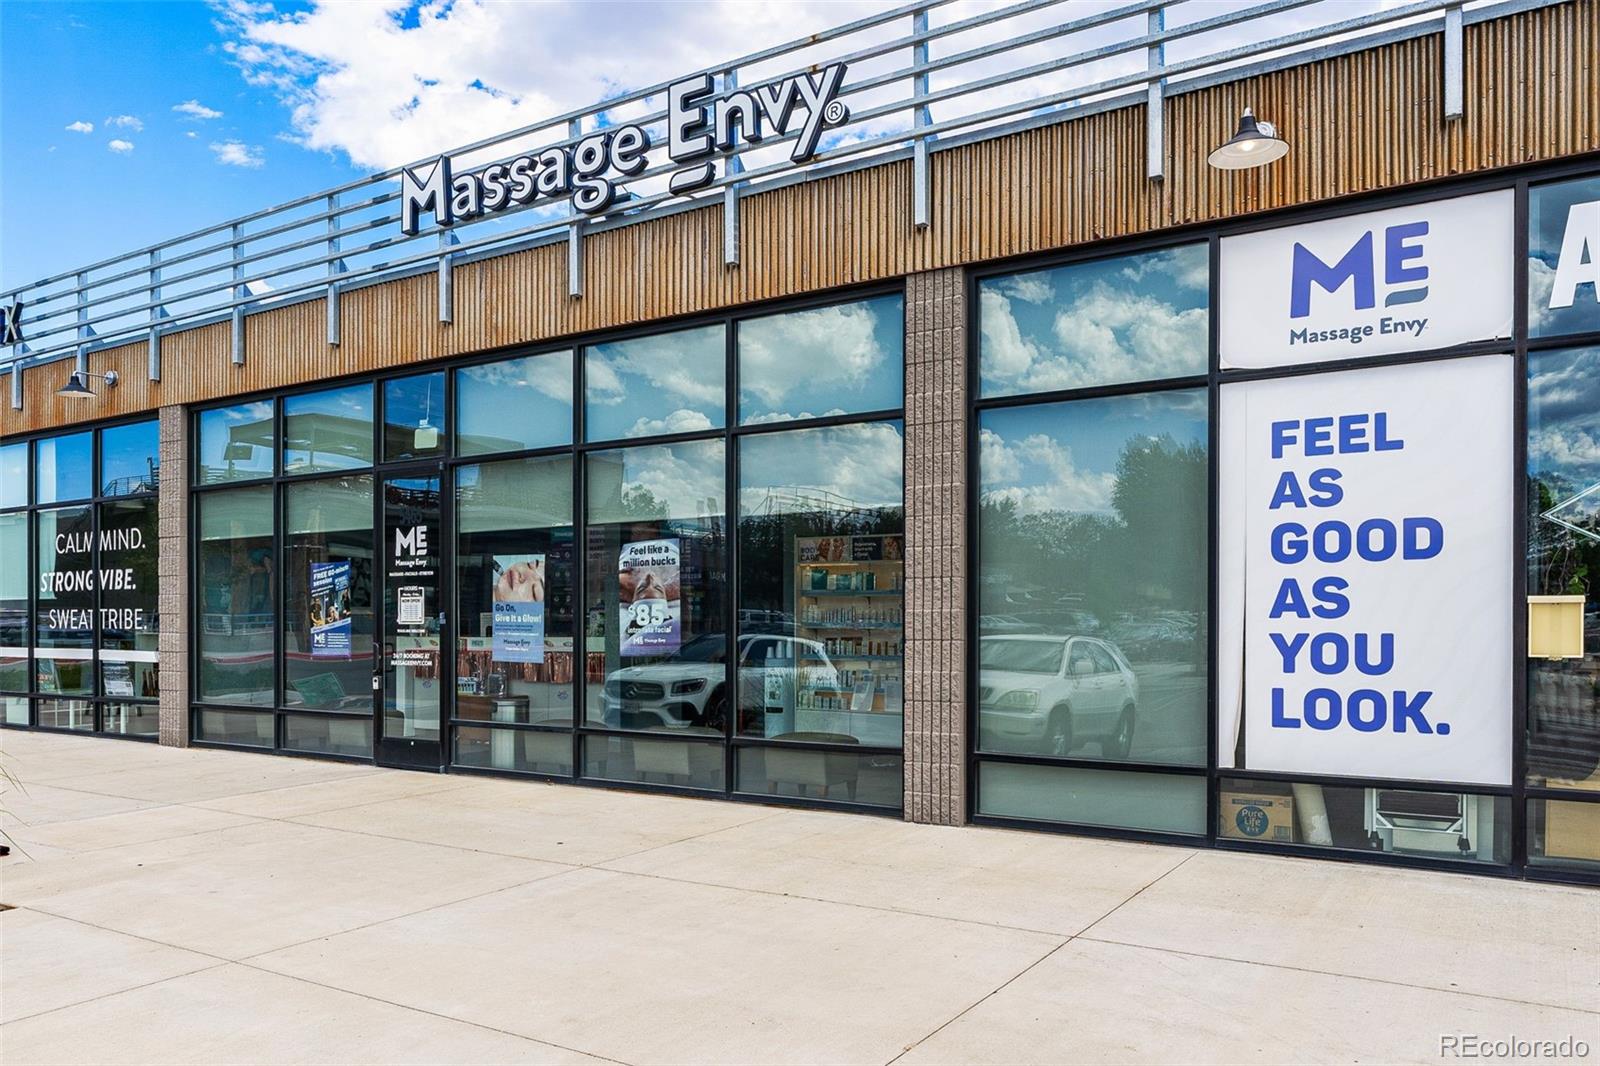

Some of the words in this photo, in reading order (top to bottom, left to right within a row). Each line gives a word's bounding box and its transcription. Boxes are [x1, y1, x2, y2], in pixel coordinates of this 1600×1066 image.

[401, 124, 651, 235] Massage
[1290, 221, 1429, 319] ME
[1289, 325, 1374, 345] Massage
[1380, 317, 1428, 337] Envy
[1271, 412, 1404, 459] FEEL
[1269, 467, 1344, 510] AS
[99, 528, 146, 551] MIND.
[395, 525, 428, 557] ME
[629, 546, 647, 556] Feel
[647, 545, 663, 555] like
[663, 546, 669, 554] a
[1270, 517, 1444, 565] GOOD
[623, 558, 650, 568] million
[651, 557, 676, 567] bucks
[40, 569, 93, 592] STRONG
[99, 568, 136, 590] VIBE.
[495, 604, 505, 612] Go
[1269, 576, 1350, 619] AS
[99, 608, 147, 630] TRIBE.
[495, 614, 510, 623] Give
[628, 603, 665, 626] $85
[1268, 632, 1394, 675] YOU
[1271, 688, 1450, 736] LOOK.
